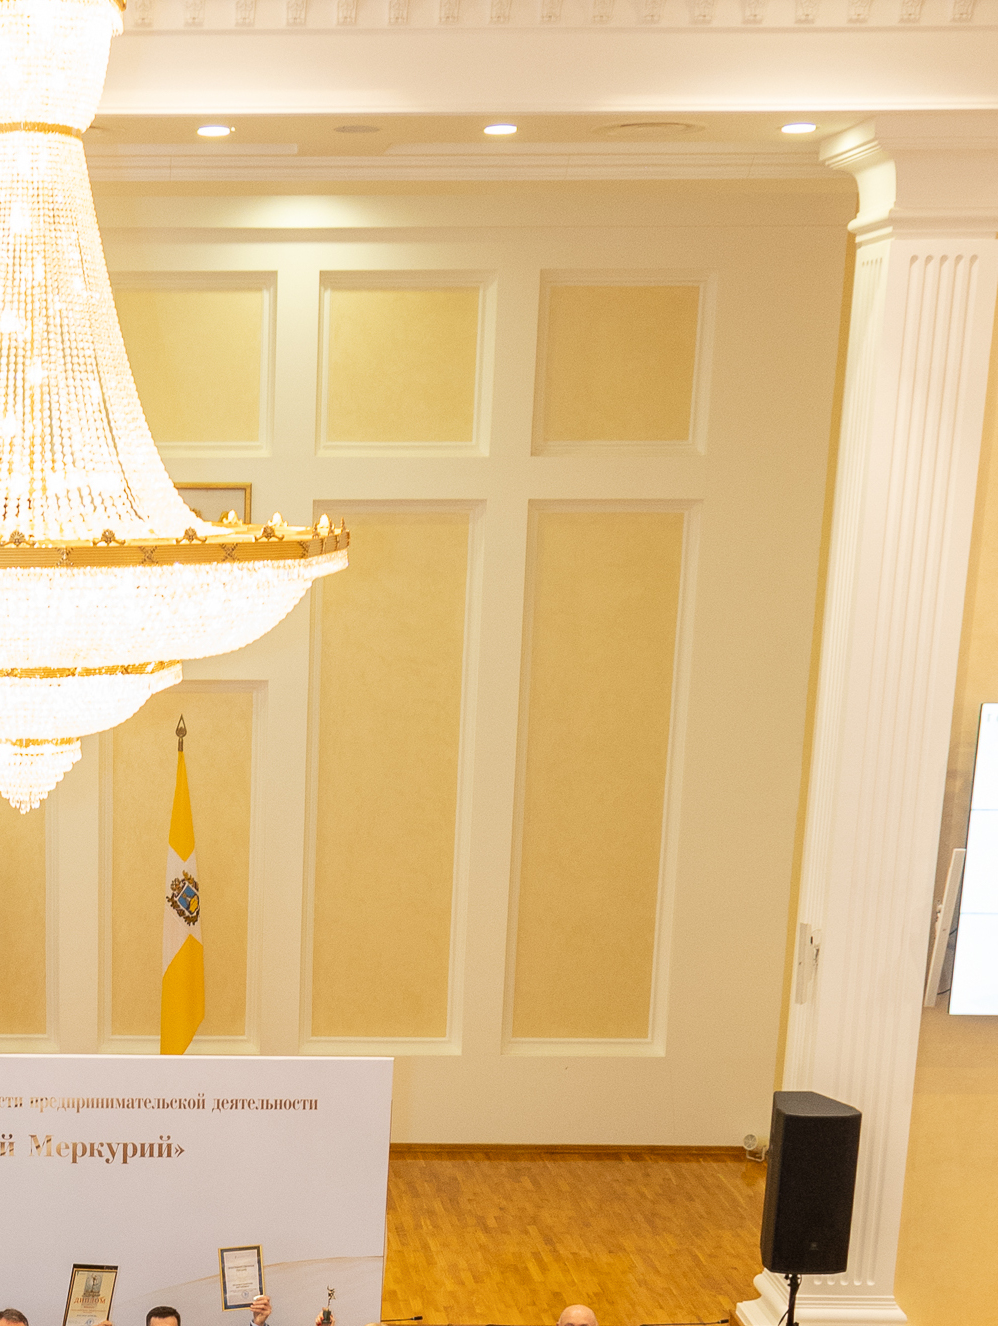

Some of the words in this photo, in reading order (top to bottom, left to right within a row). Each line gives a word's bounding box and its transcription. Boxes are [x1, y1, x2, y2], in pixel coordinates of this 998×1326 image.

[30, 1093, 206, 1113] предпринимательской
[212, 1098, 318, 1113] деятельности
[29, 1135, 185, 1164] Меркурий»
